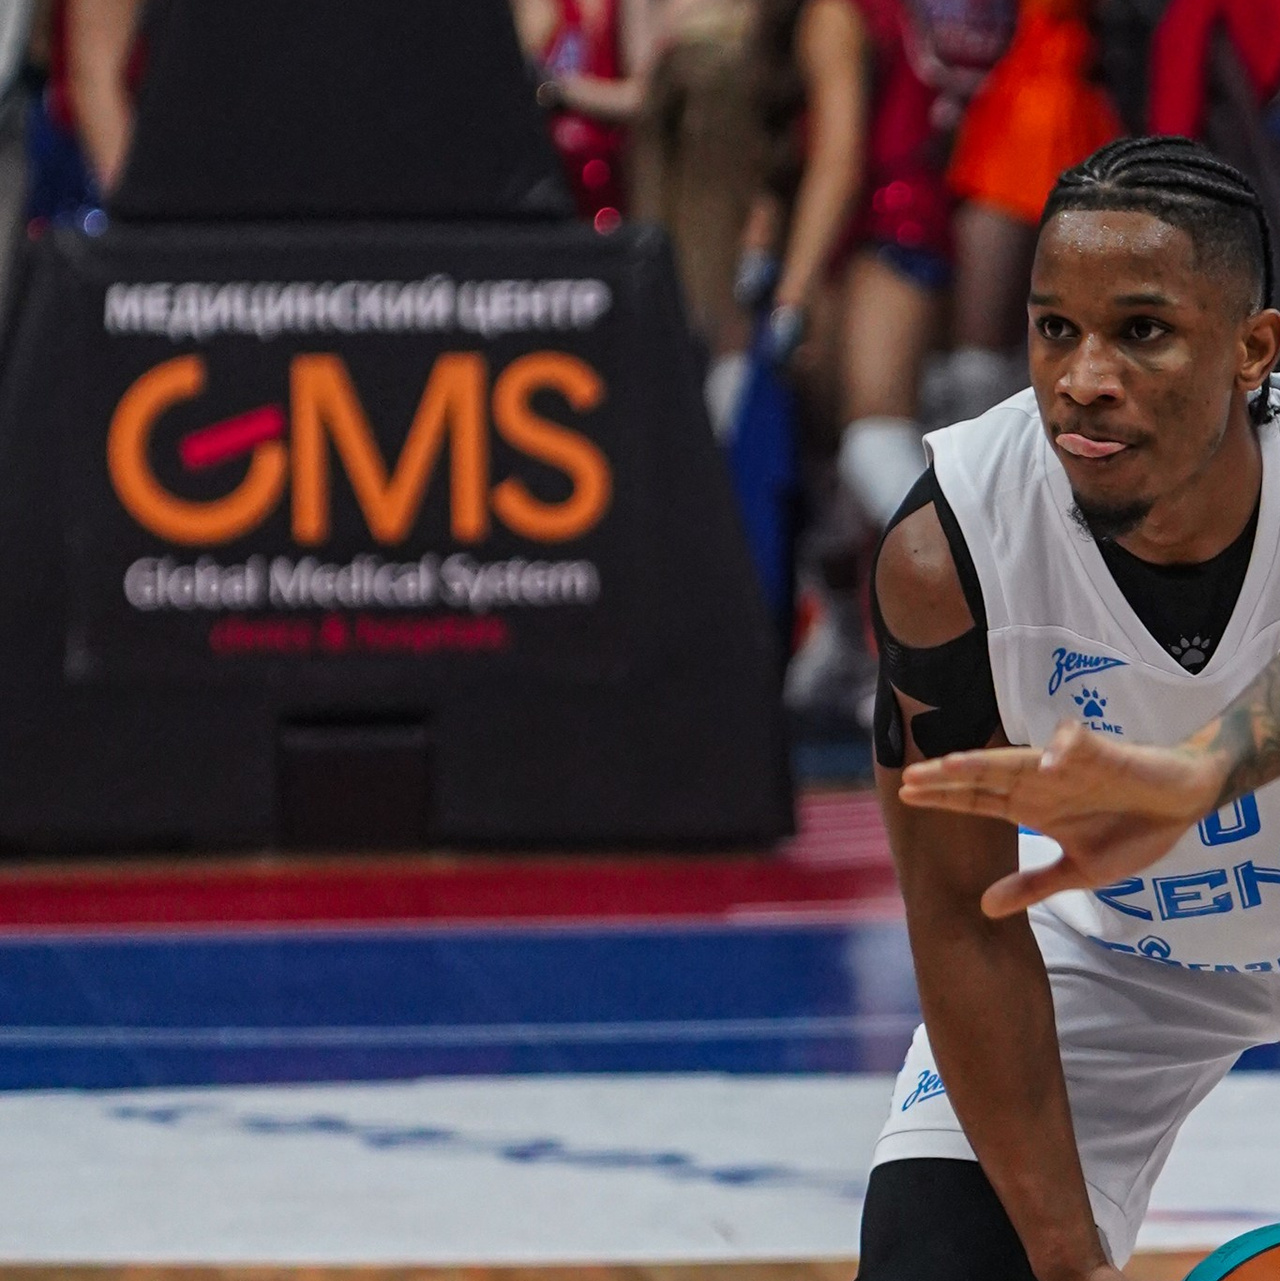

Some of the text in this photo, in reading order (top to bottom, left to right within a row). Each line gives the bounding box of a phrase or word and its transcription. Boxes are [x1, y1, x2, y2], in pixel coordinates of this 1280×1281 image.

[105, 276, 611, 339] МЕДИЦИНСКИЙ ЦЕНТР
[106, 350, 613, 546] GMS
[123, 554, 601, 613] Global Medical System
